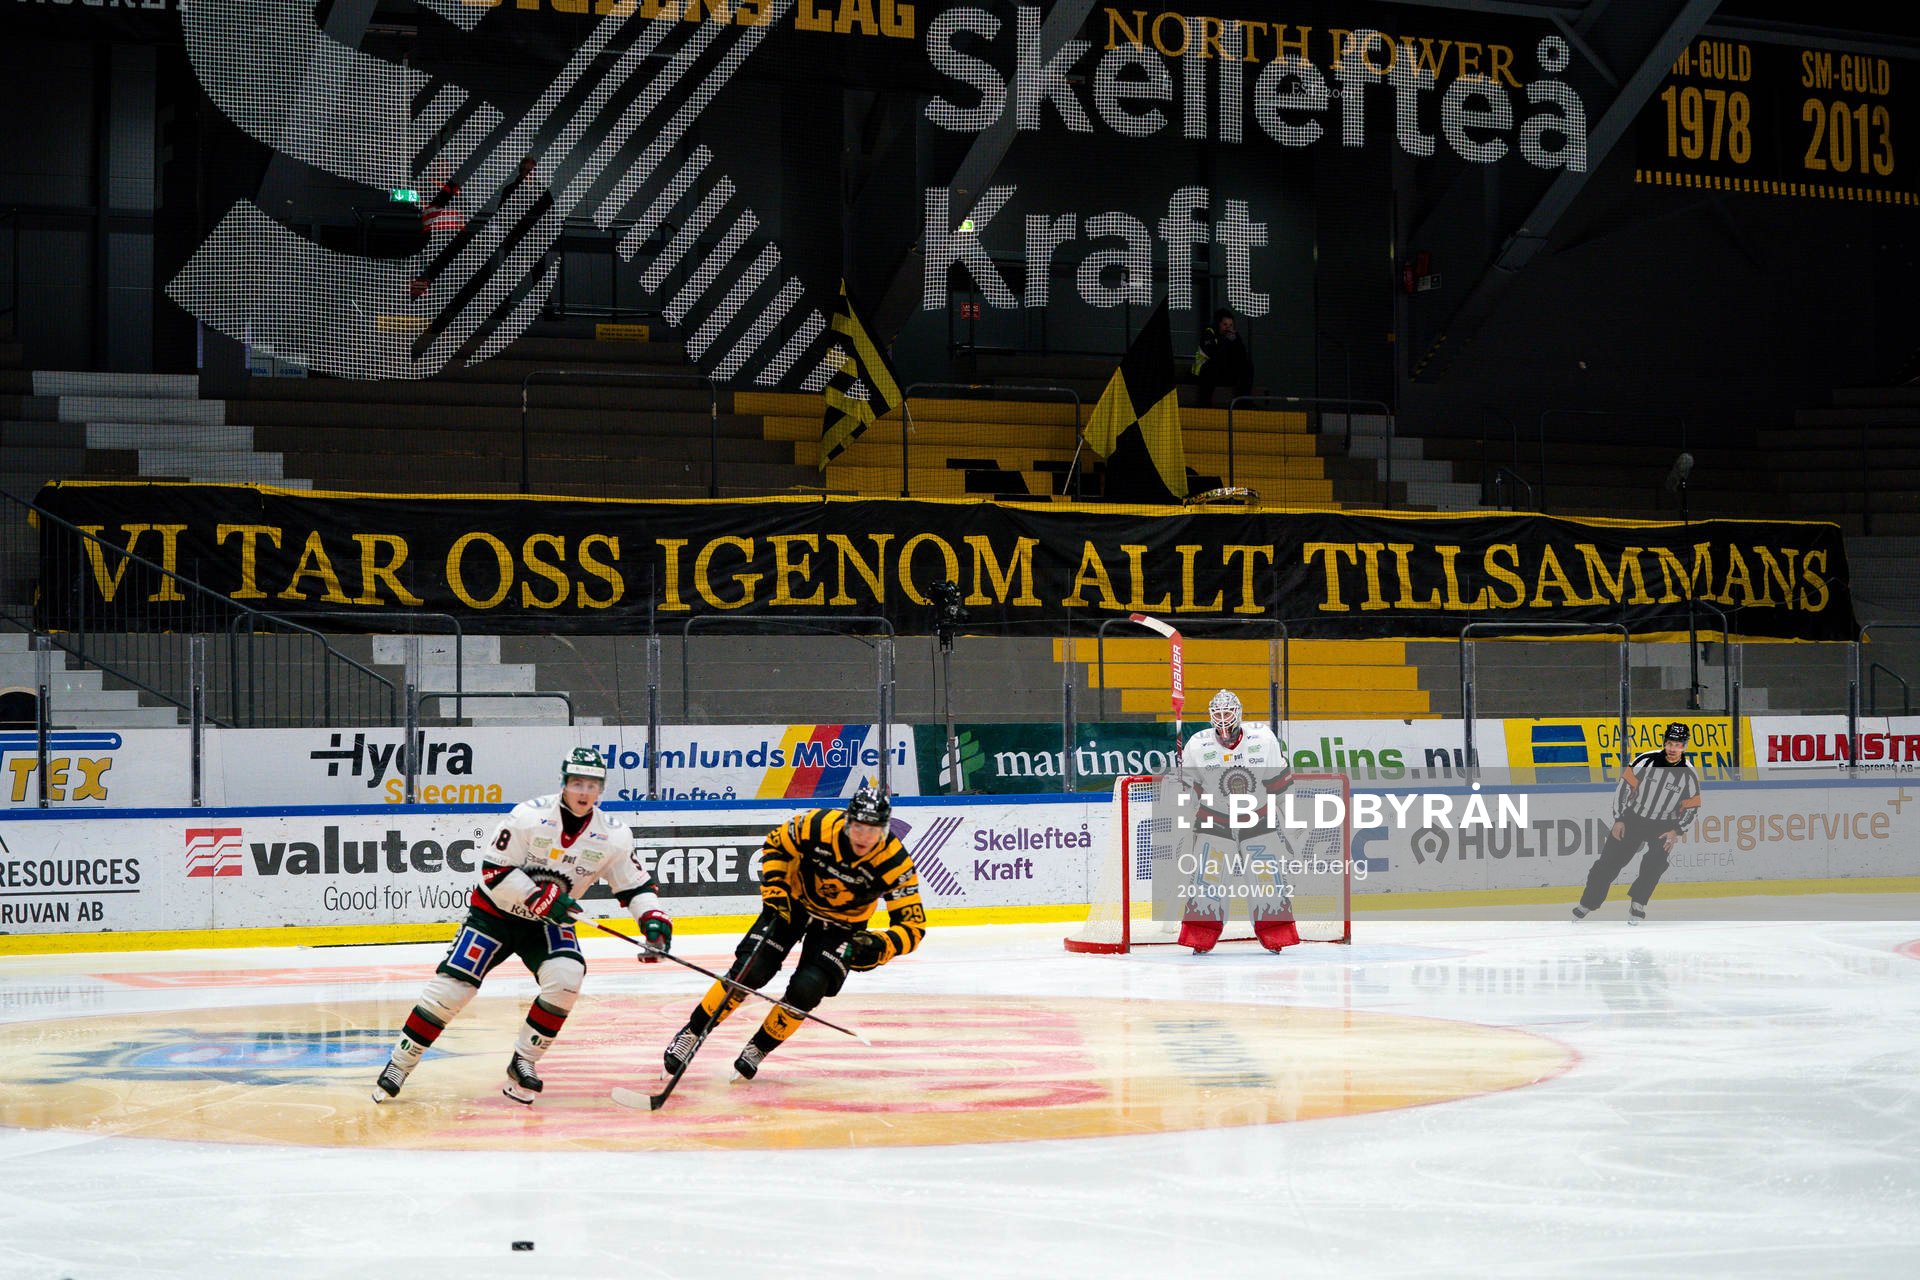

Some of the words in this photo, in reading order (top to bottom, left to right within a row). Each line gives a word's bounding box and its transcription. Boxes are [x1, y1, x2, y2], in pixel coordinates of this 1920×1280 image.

[1103, 7, 1313, 67] NORTH
[1329, 27, 1524, 88] POWER
[1672, 40, 1752, 82] M-GULD
[924, 5, 1588, 173] Skellefteå
[1801, 49, 1891, 96] SM-GULD
[1661, 85, 1752, 164] 1978
[1802, 97, 1895, 176] 2013
[922, 185, 1270, 317] Kraft
[77, 523, 187, 602] VI
[215, 523, 426, 607] TAR
[446, 531, 626, 611] OSS
[655, 533, 1044, 612] IGENOM
[1061, 540, 1273, 615] ALLT
[1303, 541, 1830, 613] TILLSAMMANS
[791, 739, 906, 768] Måleri
[1597, 723, 1729, 749] GARAGORT
[311, 730, 474, 788] Hydra
[993, 740, 1180, 777] martinson
[1280, 737, 1481, 780] elins.nu
[9, 757, 113, 802] TEX
[384, 778, 502, 804] Secma
[617, 786, 737, 801] Skllefteå
[973, 823, 1092, 851] Skellefteå
[973, 857, 1033, 881] Kraft
[1668, 849, 1735, 868] KELLEFTEÅ
[2, 902, 69, 924] RUVAN
[77, 901, 104, 922] AB
[324, 886, 377, 911] Good
[383, 886, 412, 910] for
[901, 904, 925, 922] 29
